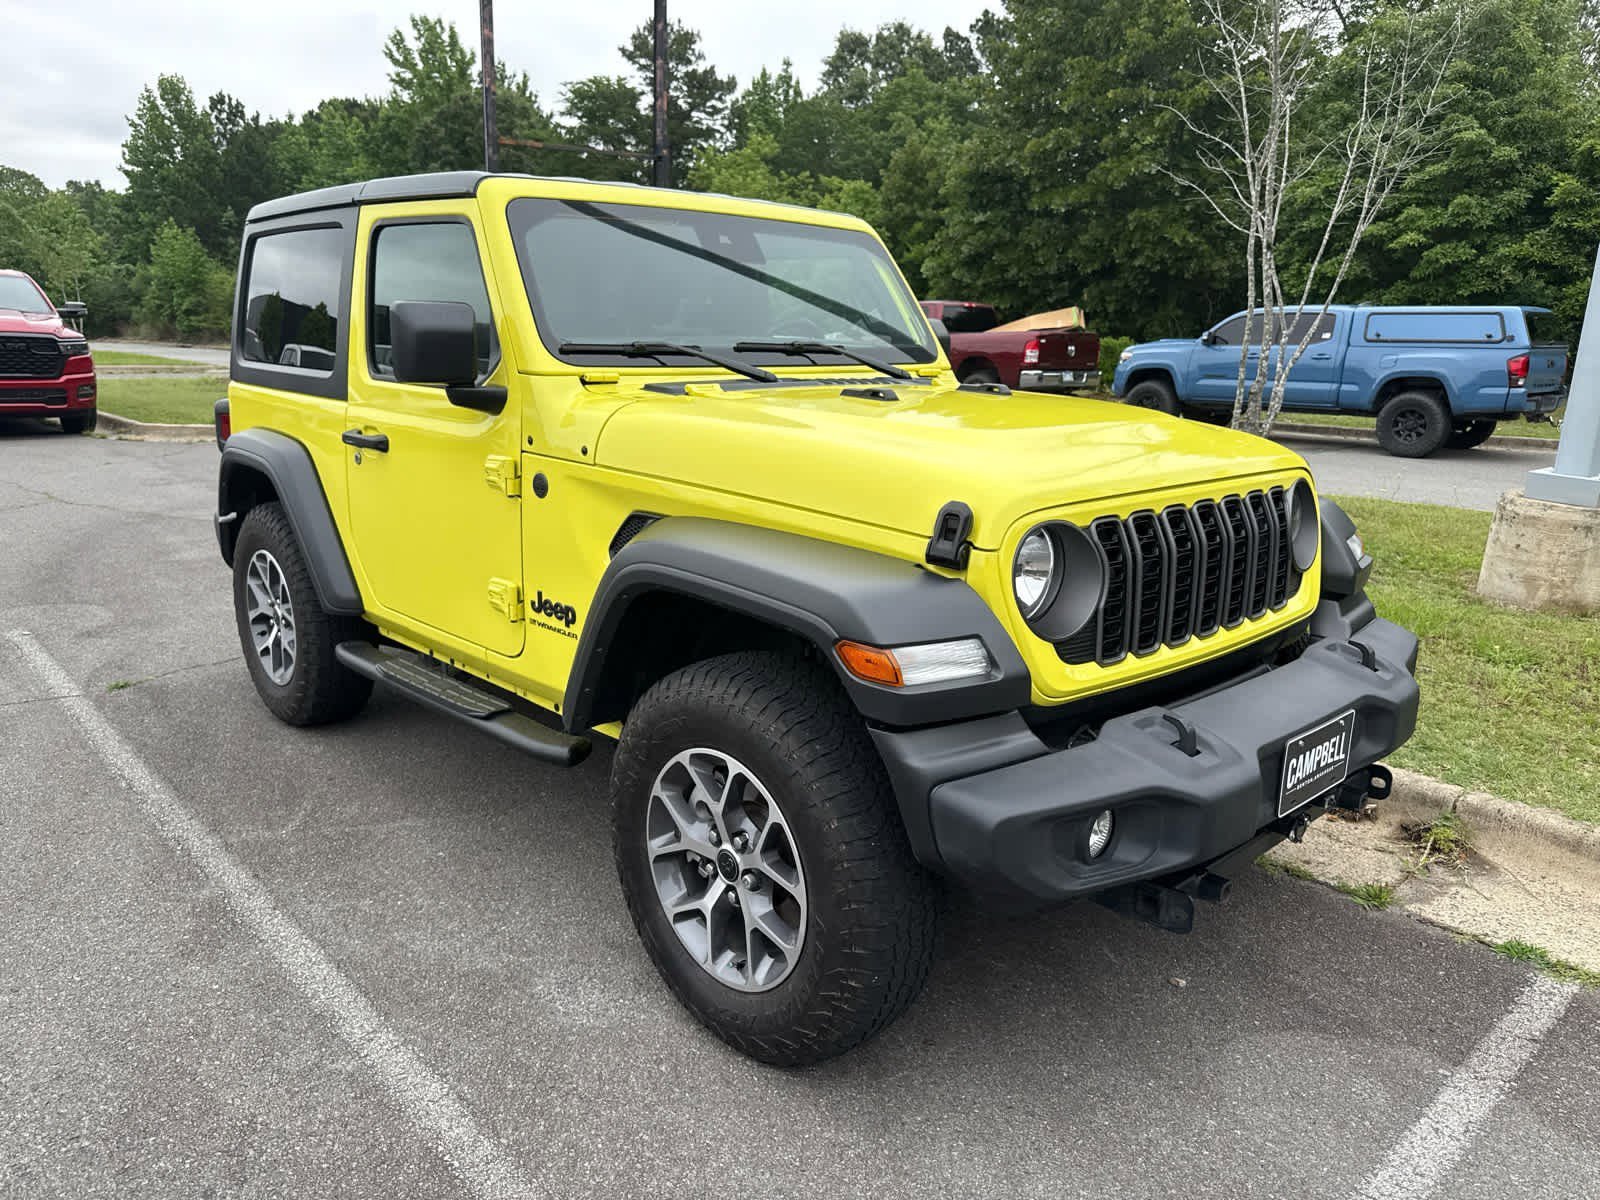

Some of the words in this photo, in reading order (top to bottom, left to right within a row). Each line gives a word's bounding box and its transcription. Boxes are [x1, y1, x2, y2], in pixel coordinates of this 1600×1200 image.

[530, 590, 577, 628] Jeep
[537, 621, 578, 640] WRANGLER
[1286, 732, 1345, 789] CAMPBELL
